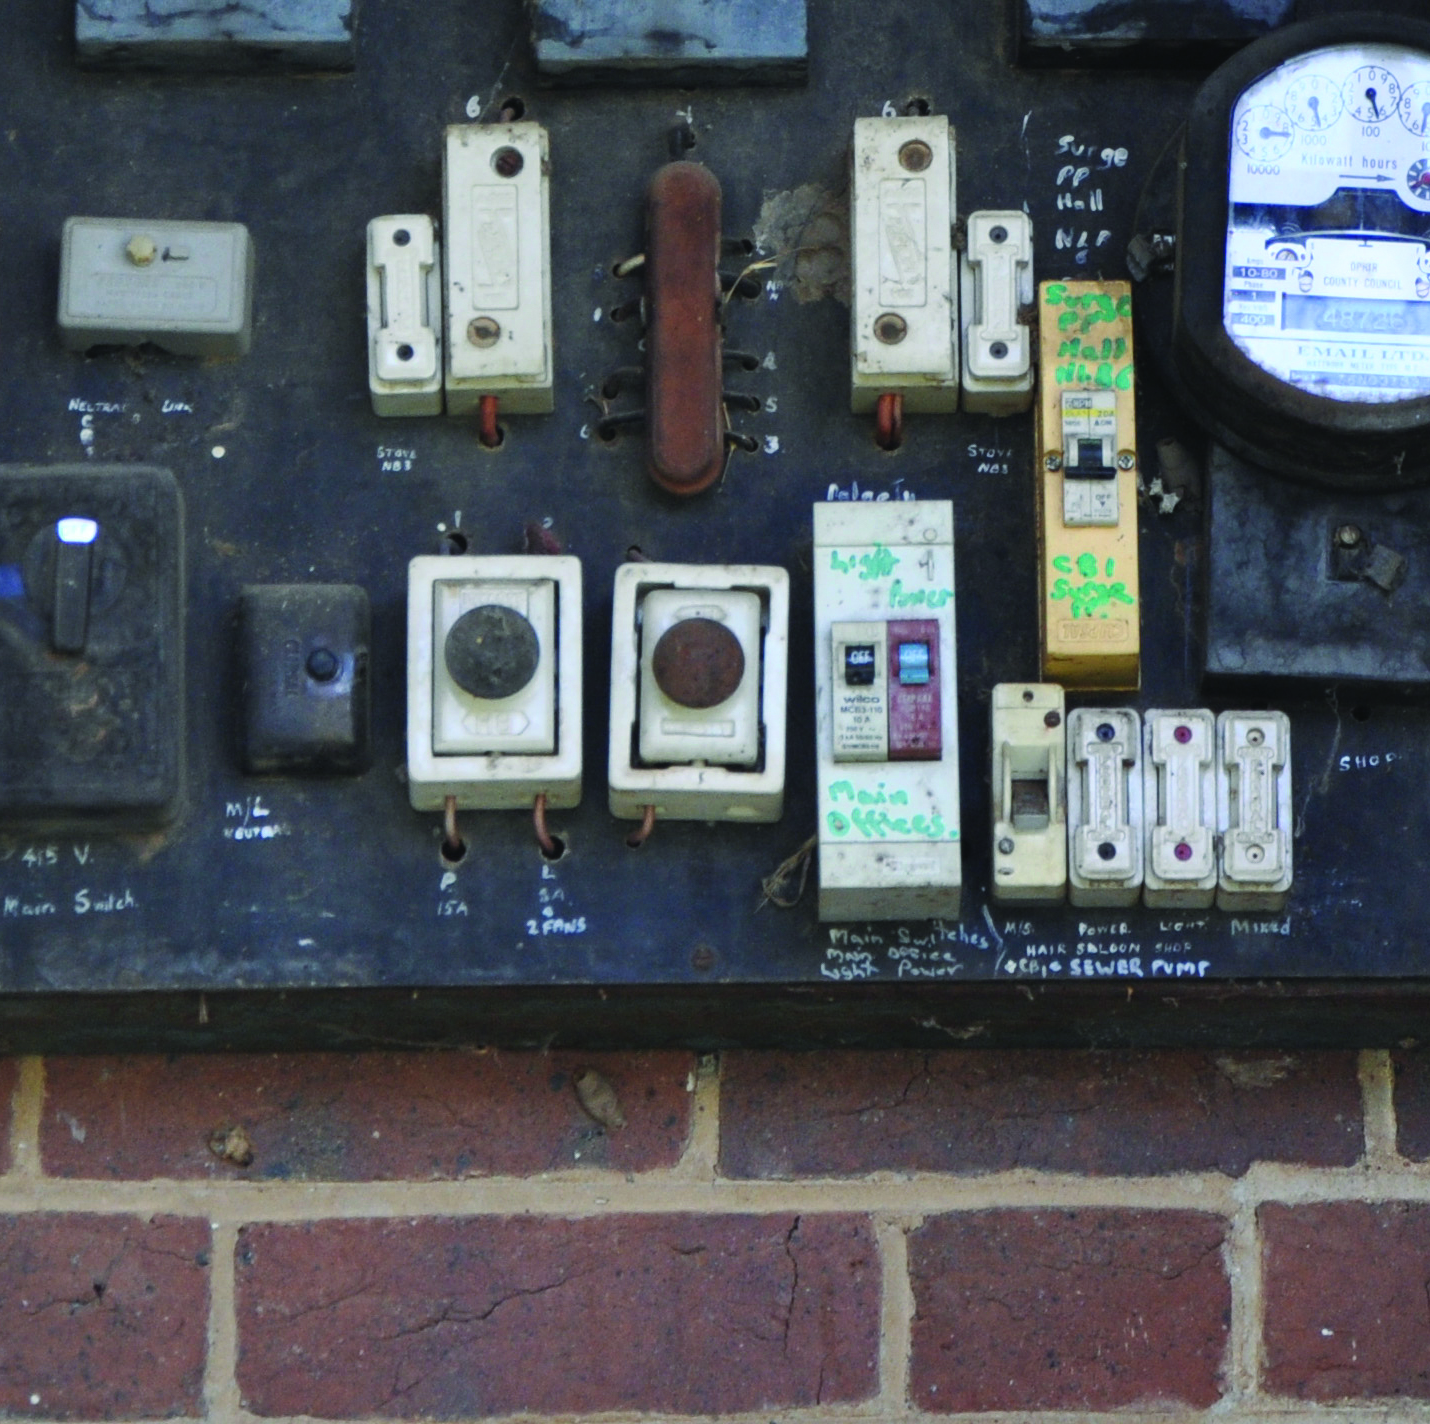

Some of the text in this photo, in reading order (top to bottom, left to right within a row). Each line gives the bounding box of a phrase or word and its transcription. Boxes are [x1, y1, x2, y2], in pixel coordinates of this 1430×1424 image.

[466, 95, 481, 118] 6
[1361, 127, 1380, 137] 100
[1055, 135, 1128, 170] Surge
[1301, 154, 1398, 170] Kilowatt hours
[1056, 165, 1090, 188] PP
[1057, 188, 1103, 211] Hall
[1240, 268, 1278, 278] 10-80
[1323, 276, 1402, 291] COUNTY COUNCIL
[1241, 314, 1266, 325] 400
[1058, 337, 1127, 361] Hall
[1297, 346, 1375, 360] EMAIL
[851, 650, 871, 664] OFF
[843, 695, 881, 704] wilco
[828, 780, 908, 805] Main
[1026, 944, 1066, 956] HAIR
[1070, 959, 1211, 977] SEWER PUMP
